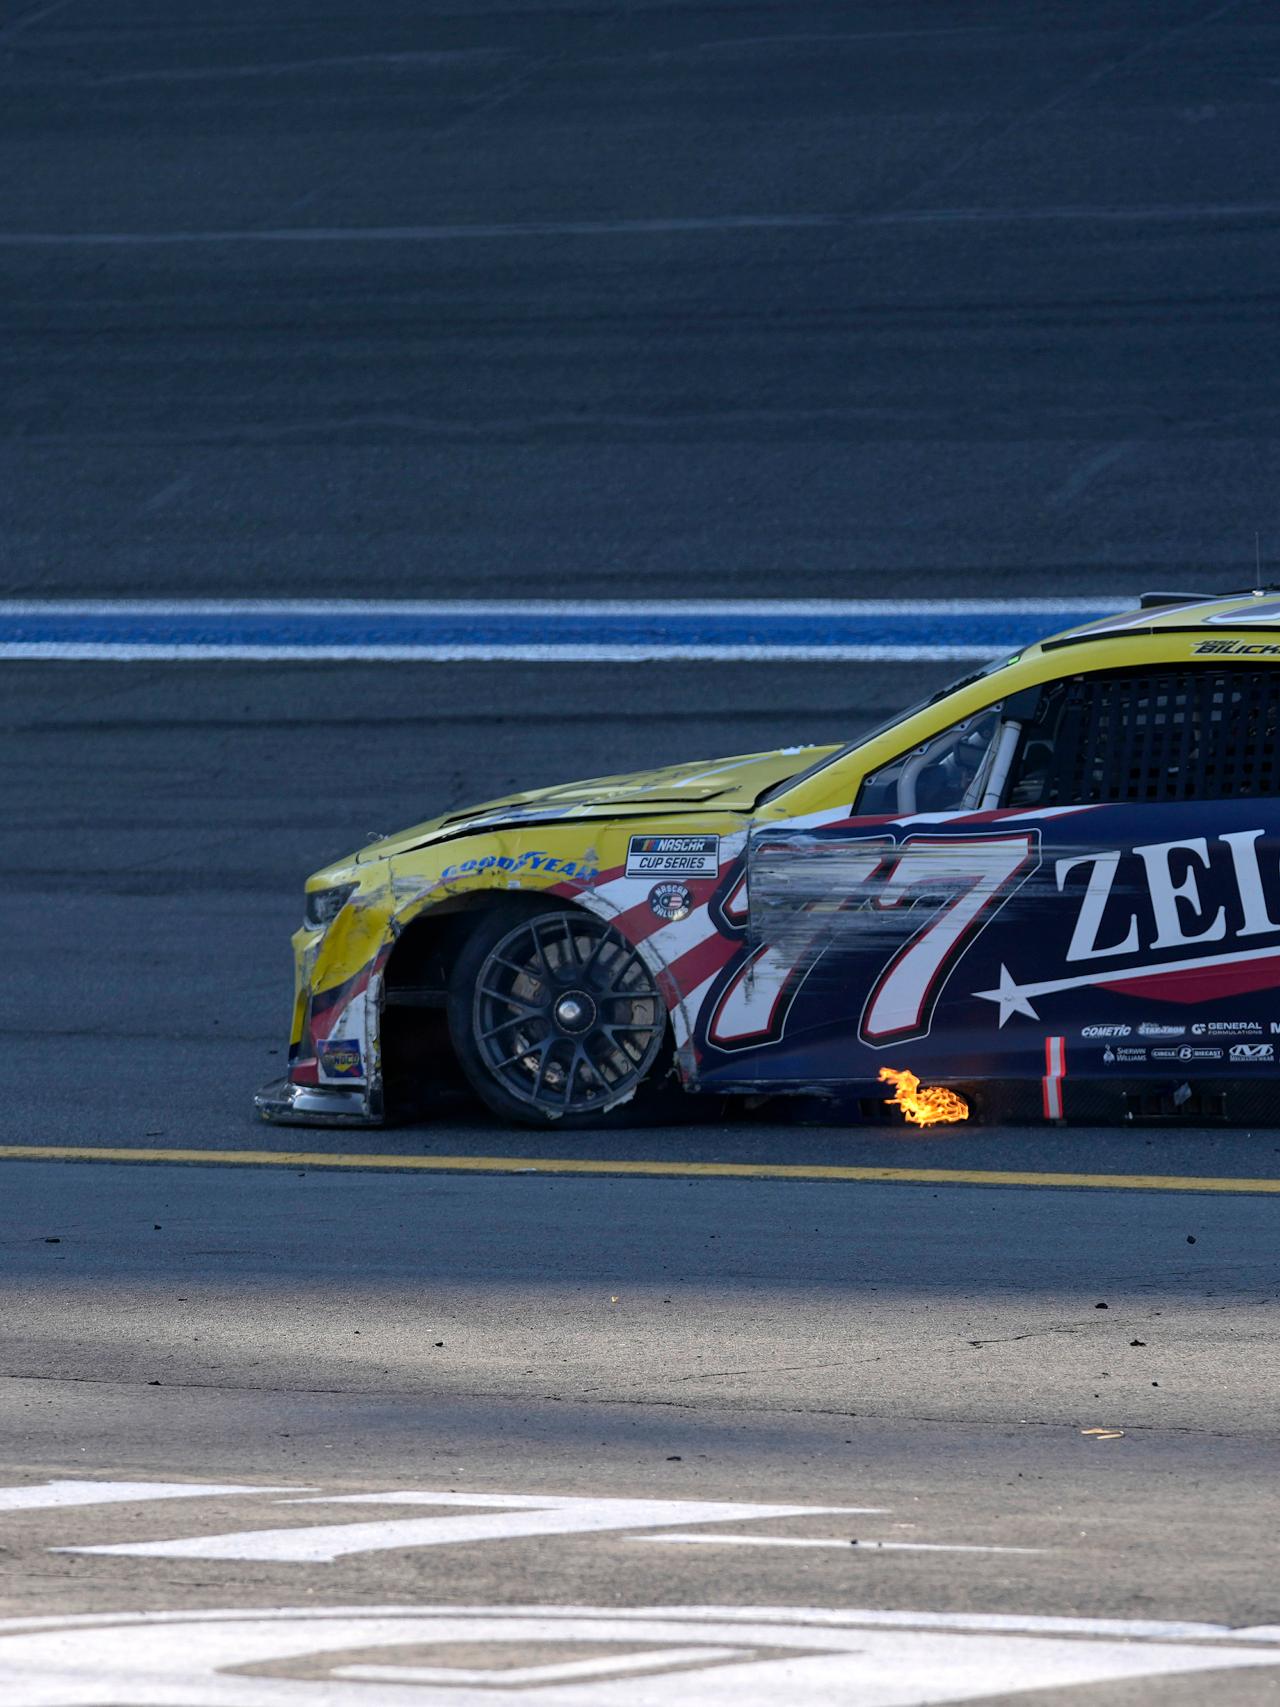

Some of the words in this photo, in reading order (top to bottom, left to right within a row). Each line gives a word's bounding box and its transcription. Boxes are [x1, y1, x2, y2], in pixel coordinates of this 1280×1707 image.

[657, 839, 705, 851] NASCAR
[441, 851, 601, 881] GOODYEAR
[639, 857, 664, 868] CUP
[664, 857, 706, 868] SERIES
[654, 885, 689, 899] NASCAR
[706, 828, 1042, 1053] 77
[1208, 1022, 1262, 1030] GENERAL
[1179, 1047, 1192, 1059] B
